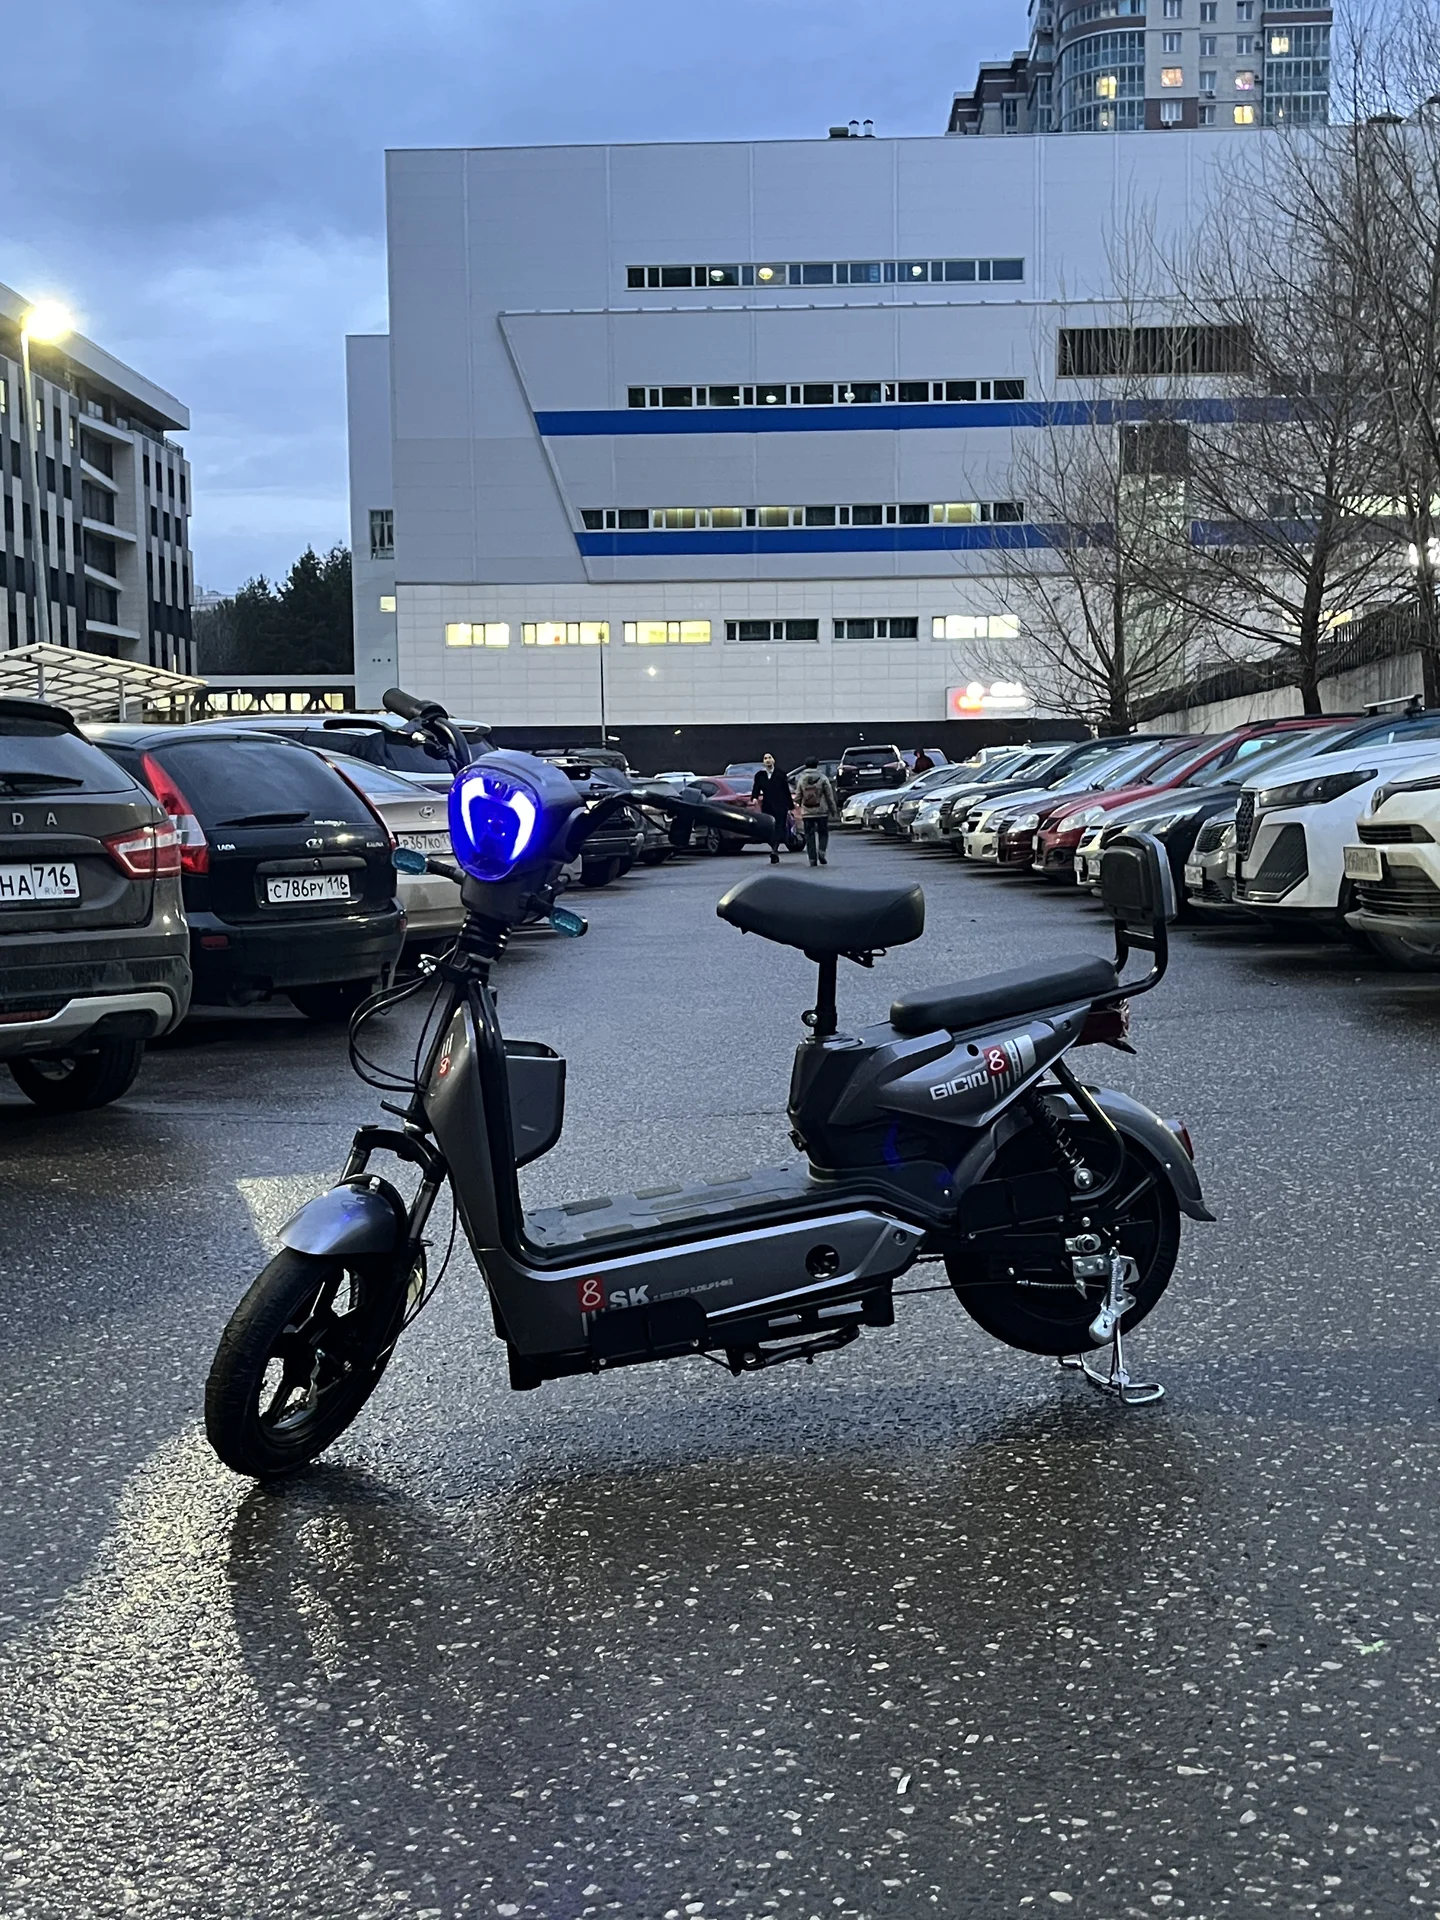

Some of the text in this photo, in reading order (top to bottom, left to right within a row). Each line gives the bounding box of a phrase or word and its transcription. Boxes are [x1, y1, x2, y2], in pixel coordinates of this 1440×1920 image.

[33, 866, 71, 888] 716
[273, 876, 348, 898] С786РУ 116
[44, 886, 64, 895] RUS
[988, 1049, 1005, 1071] 8
[581, 1279, 601, 1306] 8
